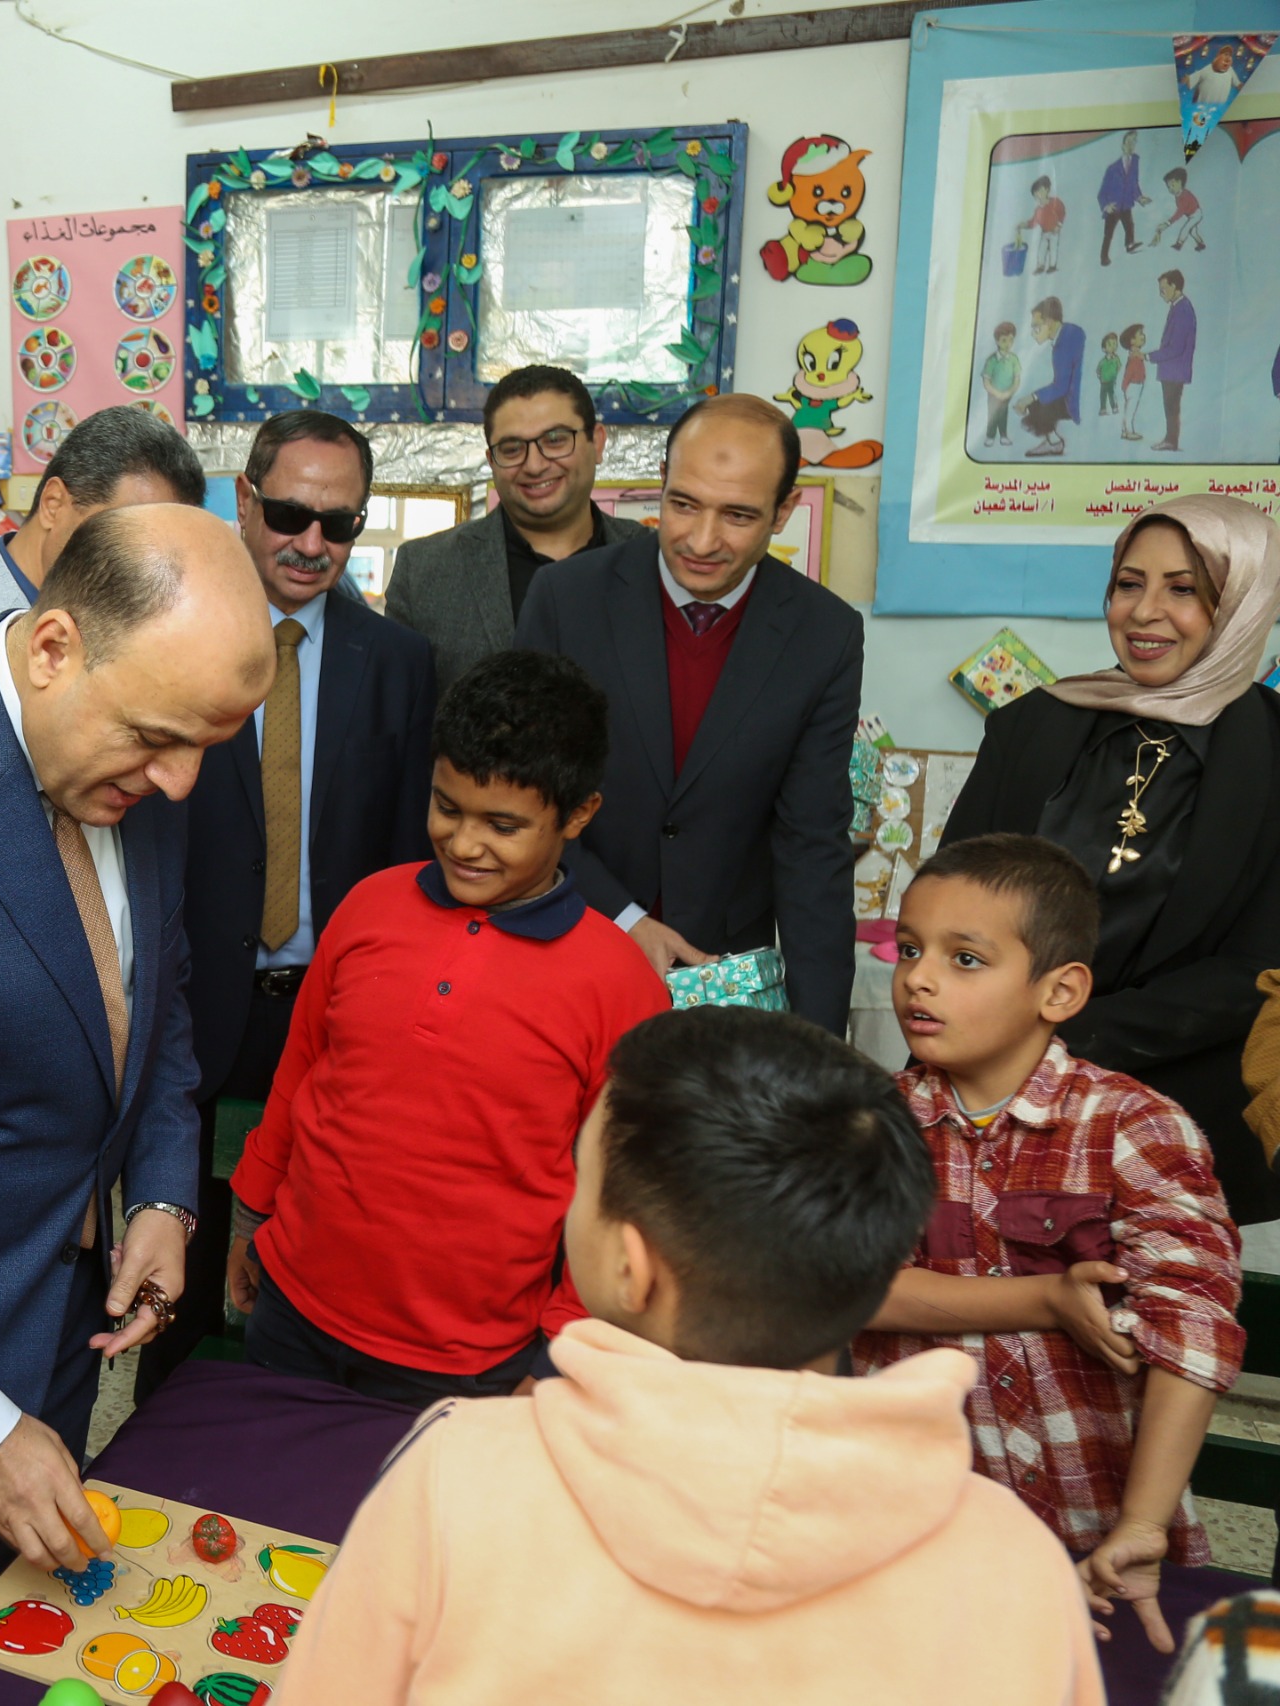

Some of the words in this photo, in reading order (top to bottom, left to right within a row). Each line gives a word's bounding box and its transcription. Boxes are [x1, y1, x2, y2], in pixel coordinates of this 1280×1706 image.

[23, 217, 78, 243] الغذاء
[79, 216, 156, 241] مجموعات
[984, 476, 1022, 494] المدرسة
[1023, 481, 1051, 496] مدير
[1104, 478, 1141, 495] الفصل
[1144, 478, 1180, 496] مدرسة
[1208, 478, 1260, 497] المجموعة
[973, 497, 1006, 515] شعبان
[1085, 501, 1120, 517] المجيد
